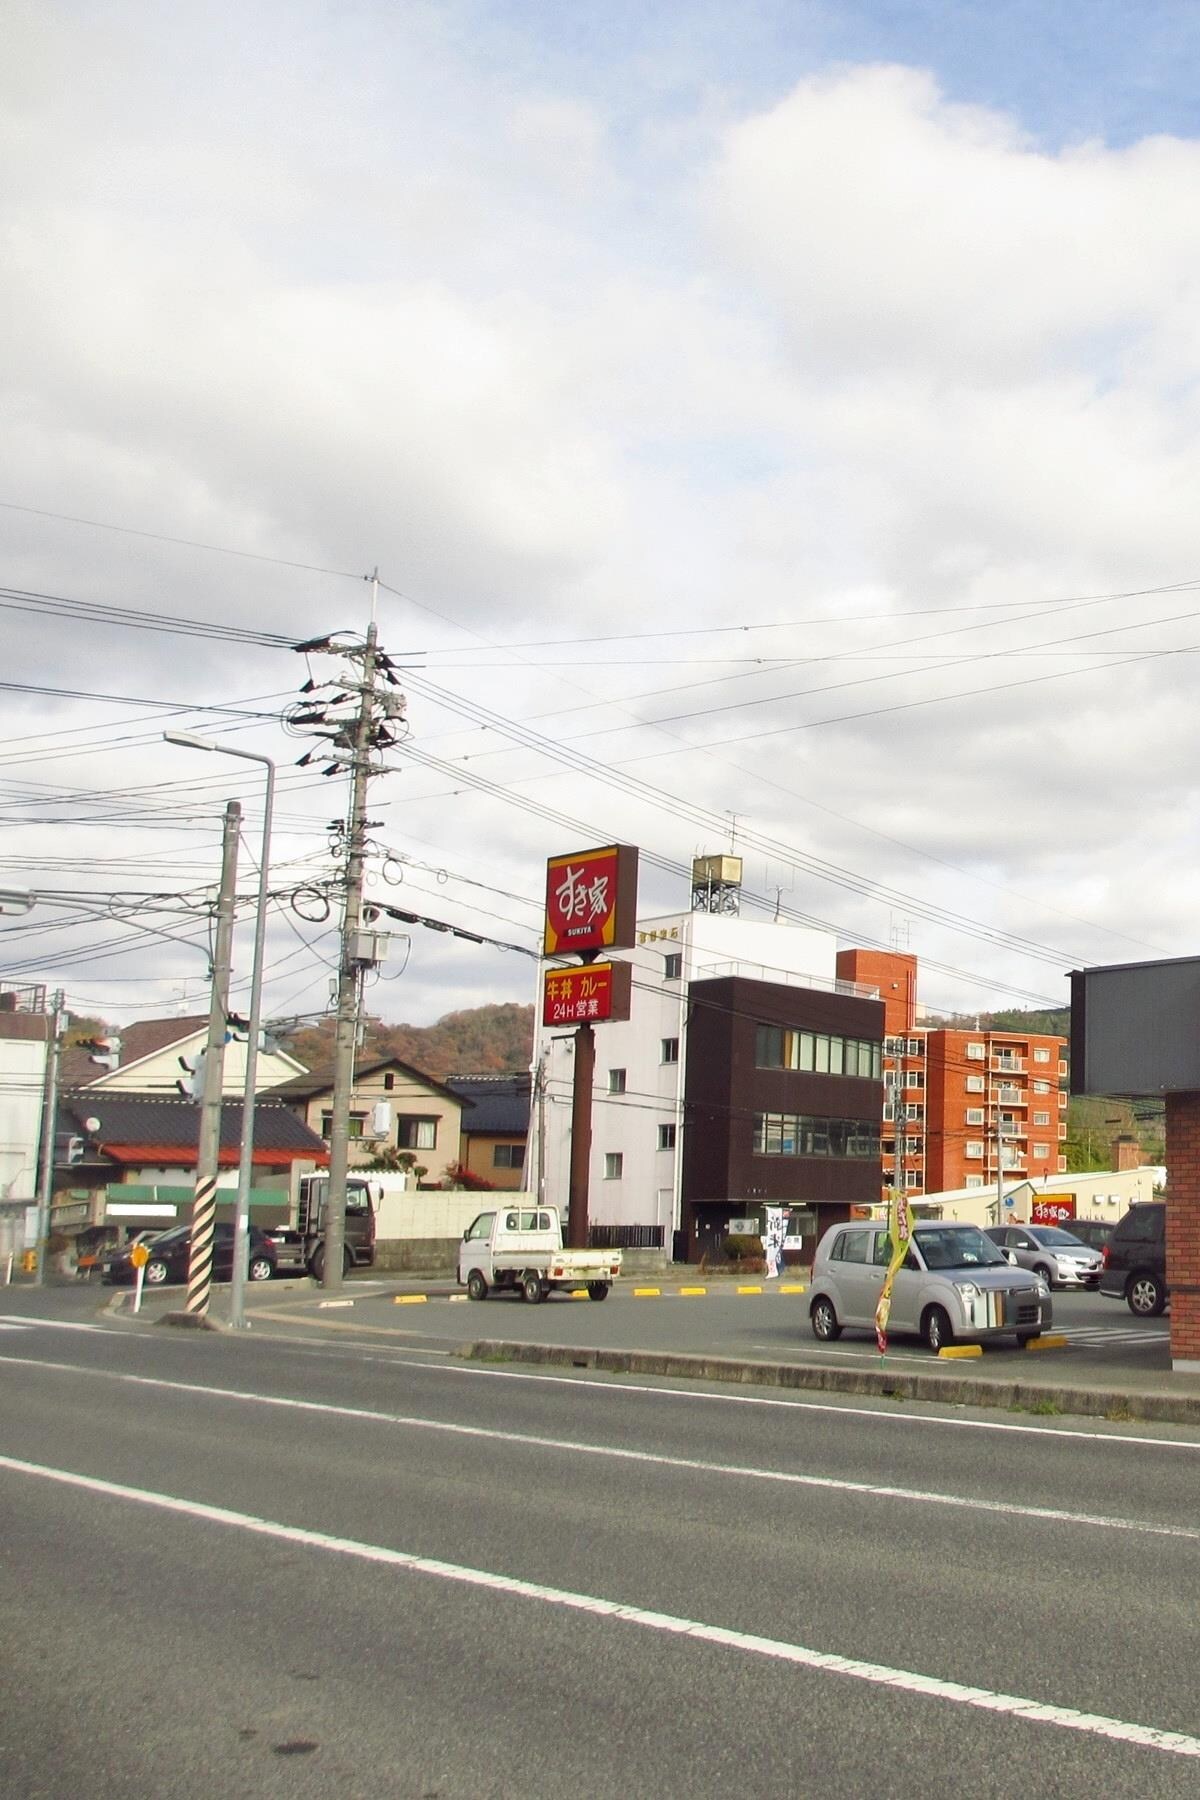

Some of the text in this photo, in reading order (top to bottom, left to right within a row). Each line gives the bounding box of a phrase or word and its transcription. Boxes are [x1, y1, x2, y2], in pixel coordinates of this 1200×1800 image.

[556, 866, 608, 923] すき家
[567, 926, 592, 937] SUKIYA
[547, 976, 608, 1001] 牛丼 カレー
[553, 998, 599, 1019] 24H営業
